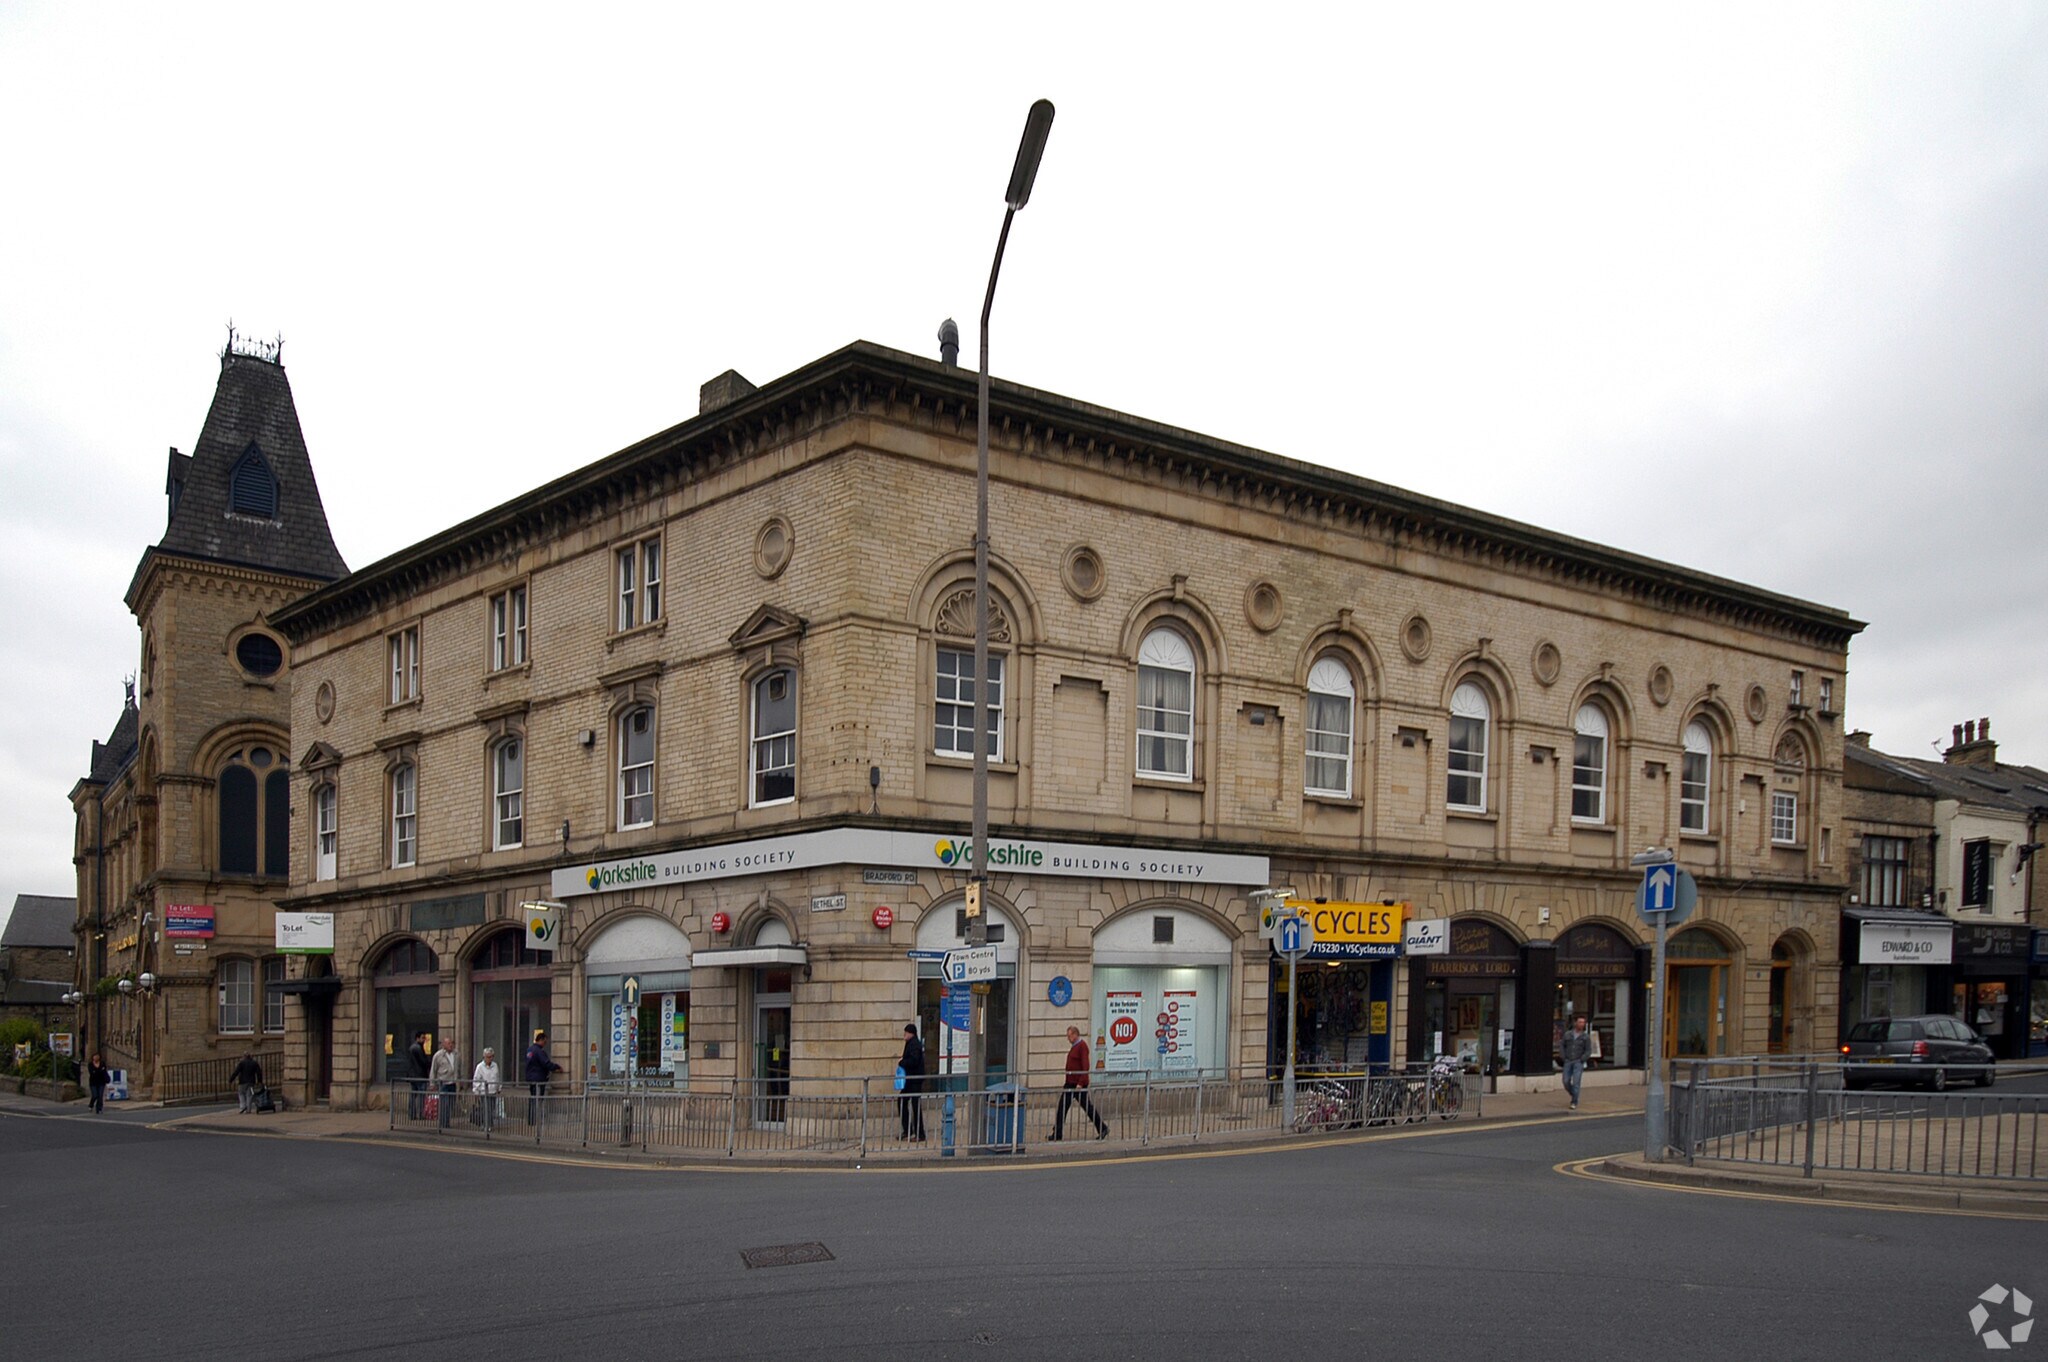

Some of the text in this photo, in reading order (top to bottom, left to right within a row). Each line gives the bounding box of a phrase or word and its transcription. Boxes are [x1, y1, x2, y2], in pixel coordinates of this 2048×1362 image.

[950, 839, 1204, 878] Yokshire BUILDING SOCIETY
[594, 850, 795, 892] Yorkshire BUILDING SOCIETY
[865, 871, 915, 881] BRADFORD RD
[813, 898, 834, 909] BETHEL
[1314, 910, 1391, 935] CYCLES
[1407, 935, 1442, 945] GIANT
[1312, 943, 1396, 956] 715230 VSCycles.co.uk
[1882, 941, 1933, 953] EDWARD & CO
[952, 951, 994, 961] Town Centre
[979, 966, 991, 976] yds
[1431, 962, 1511, 973] HARRISON LORD
[1557, 963, 1626, 974] HARRISON LORD
[1115, 1023, 1133, 1038] NO!
